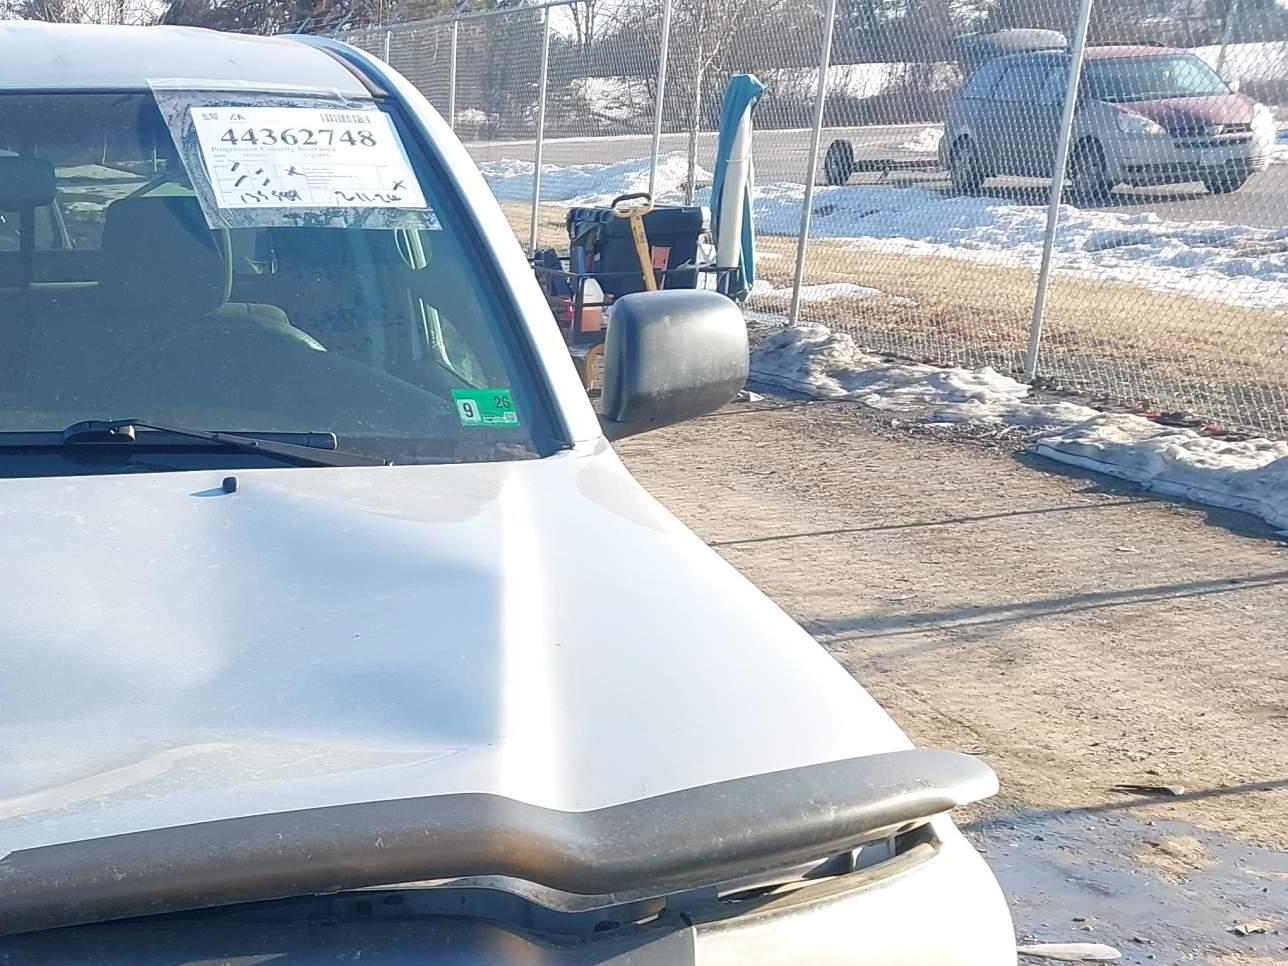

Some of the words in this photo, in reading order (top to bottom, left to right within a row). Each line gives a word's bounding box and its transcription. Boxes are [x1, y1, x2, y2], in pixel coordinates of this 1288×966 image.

[220, 127, 377, 147] 44362748
[462, 402, 474, 418] 9
[494, 395, 511, 409] 26
